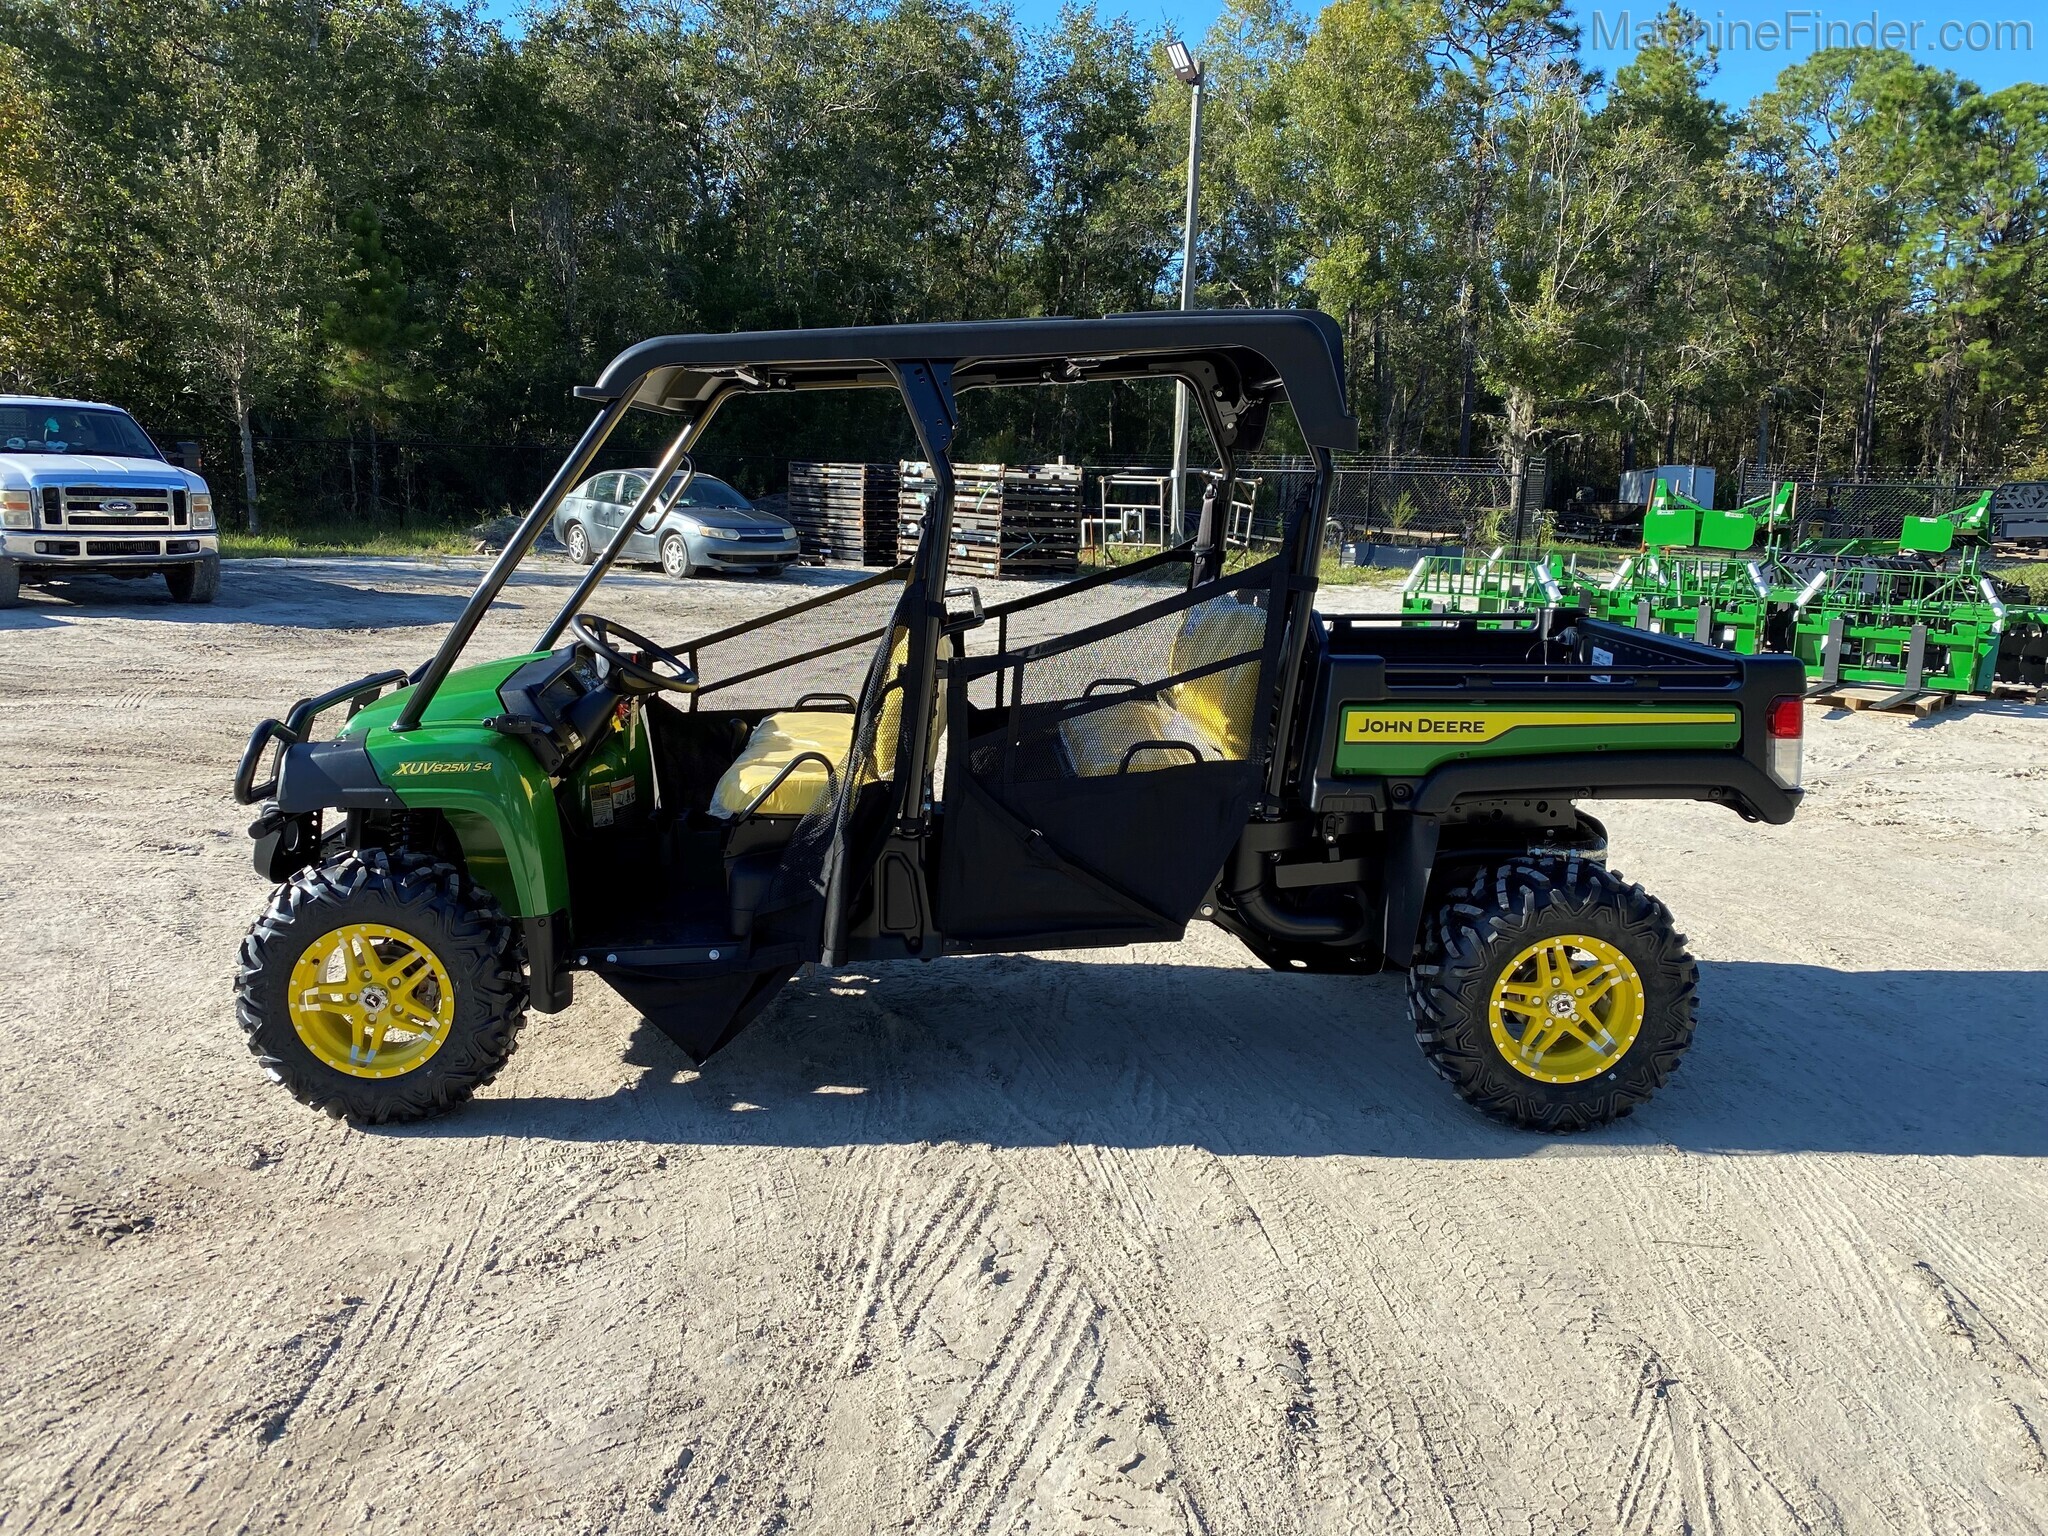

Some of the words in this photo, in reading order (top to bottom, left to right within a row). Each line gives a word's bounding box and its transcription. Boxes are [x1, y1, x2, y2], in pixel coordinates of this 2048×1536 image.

[1359, 718, 1413, 733] JOHN
[1418, 718, 1486, 733] DEERE
[393, 762, 470, 775] XUV825M
[473, 762, 492, 772] S4
